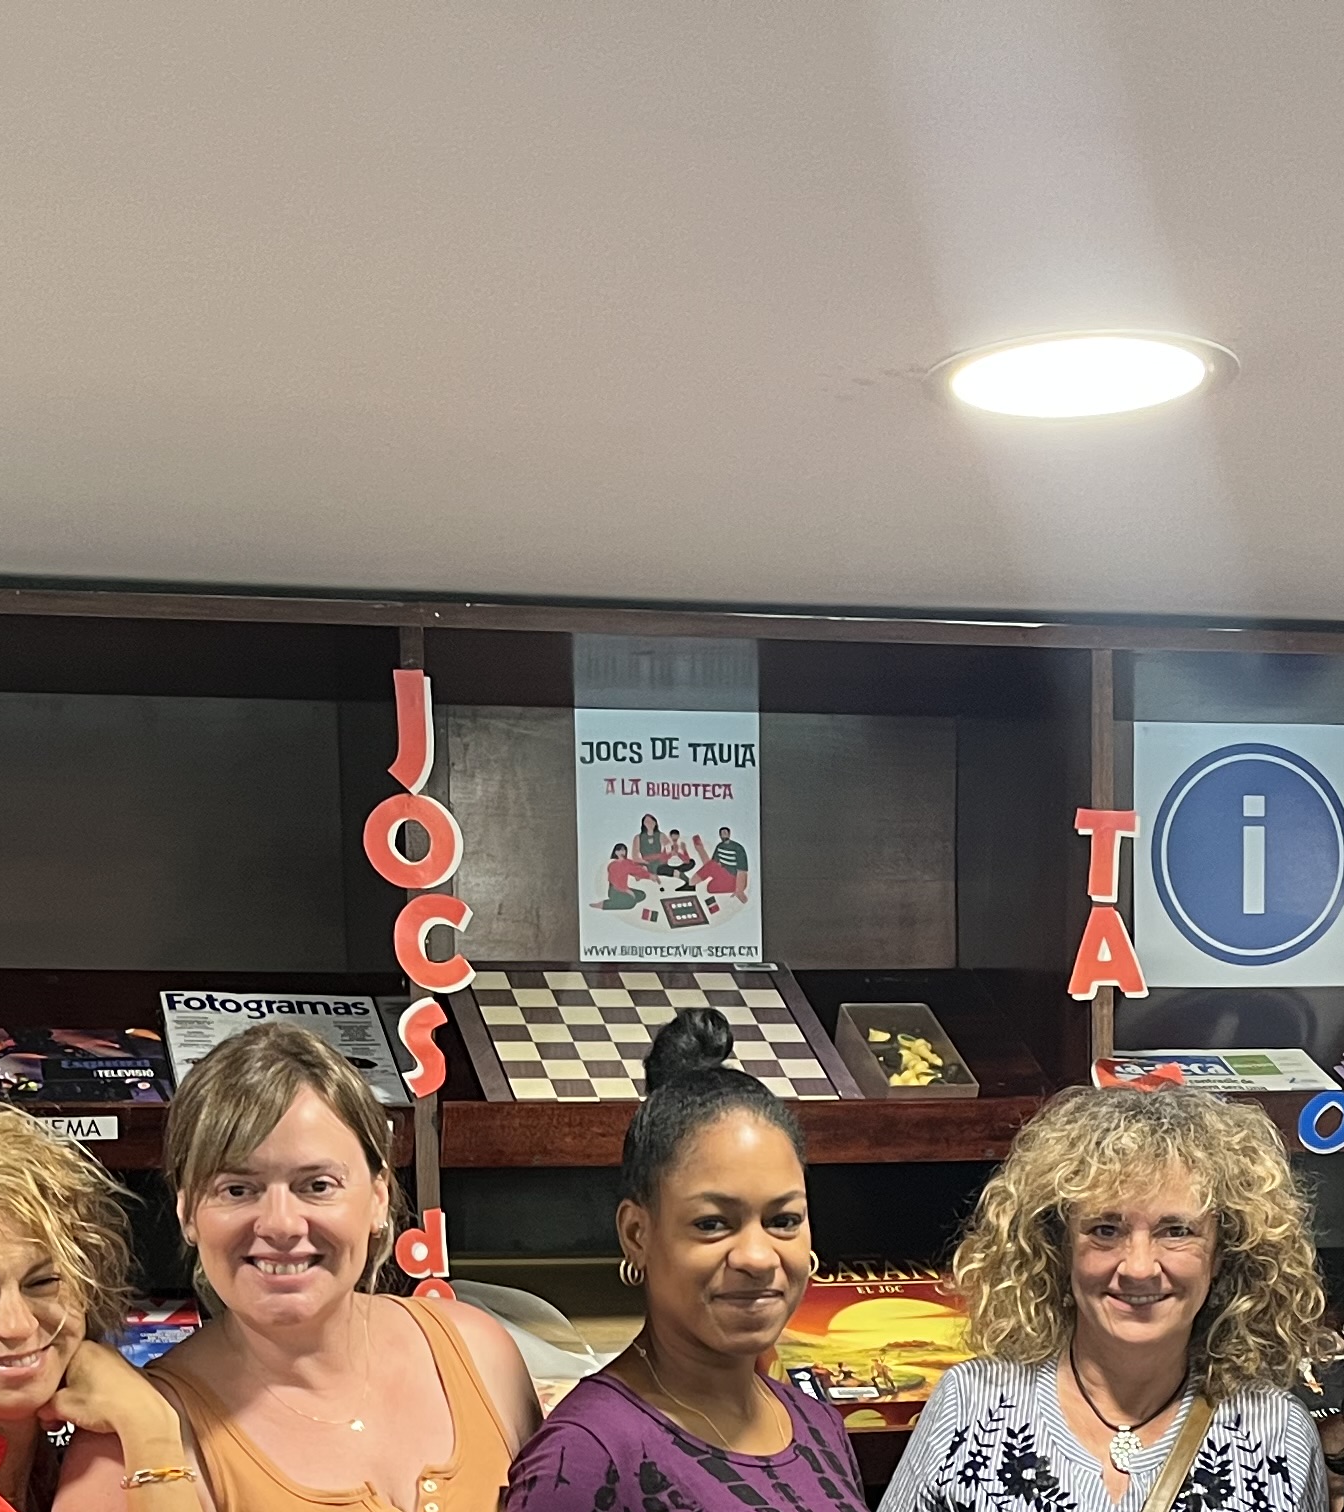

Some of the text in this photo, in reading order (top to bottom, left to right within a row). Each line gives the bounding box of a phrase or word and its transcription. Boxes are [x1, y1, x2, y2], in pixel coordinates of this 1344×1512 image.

[580, 737, 756, 768] JOCS DE TAULA
[604, 778, 734, 800] A LA BIBLIOTECA
[164, 993, 370, 1019] Fotogramas
[98, 1068, 155, 1078] TELEVISIÓ
[812, 1258, 941, 1283] CATAN
[856, 1285, 905, 1294] EL JOC
